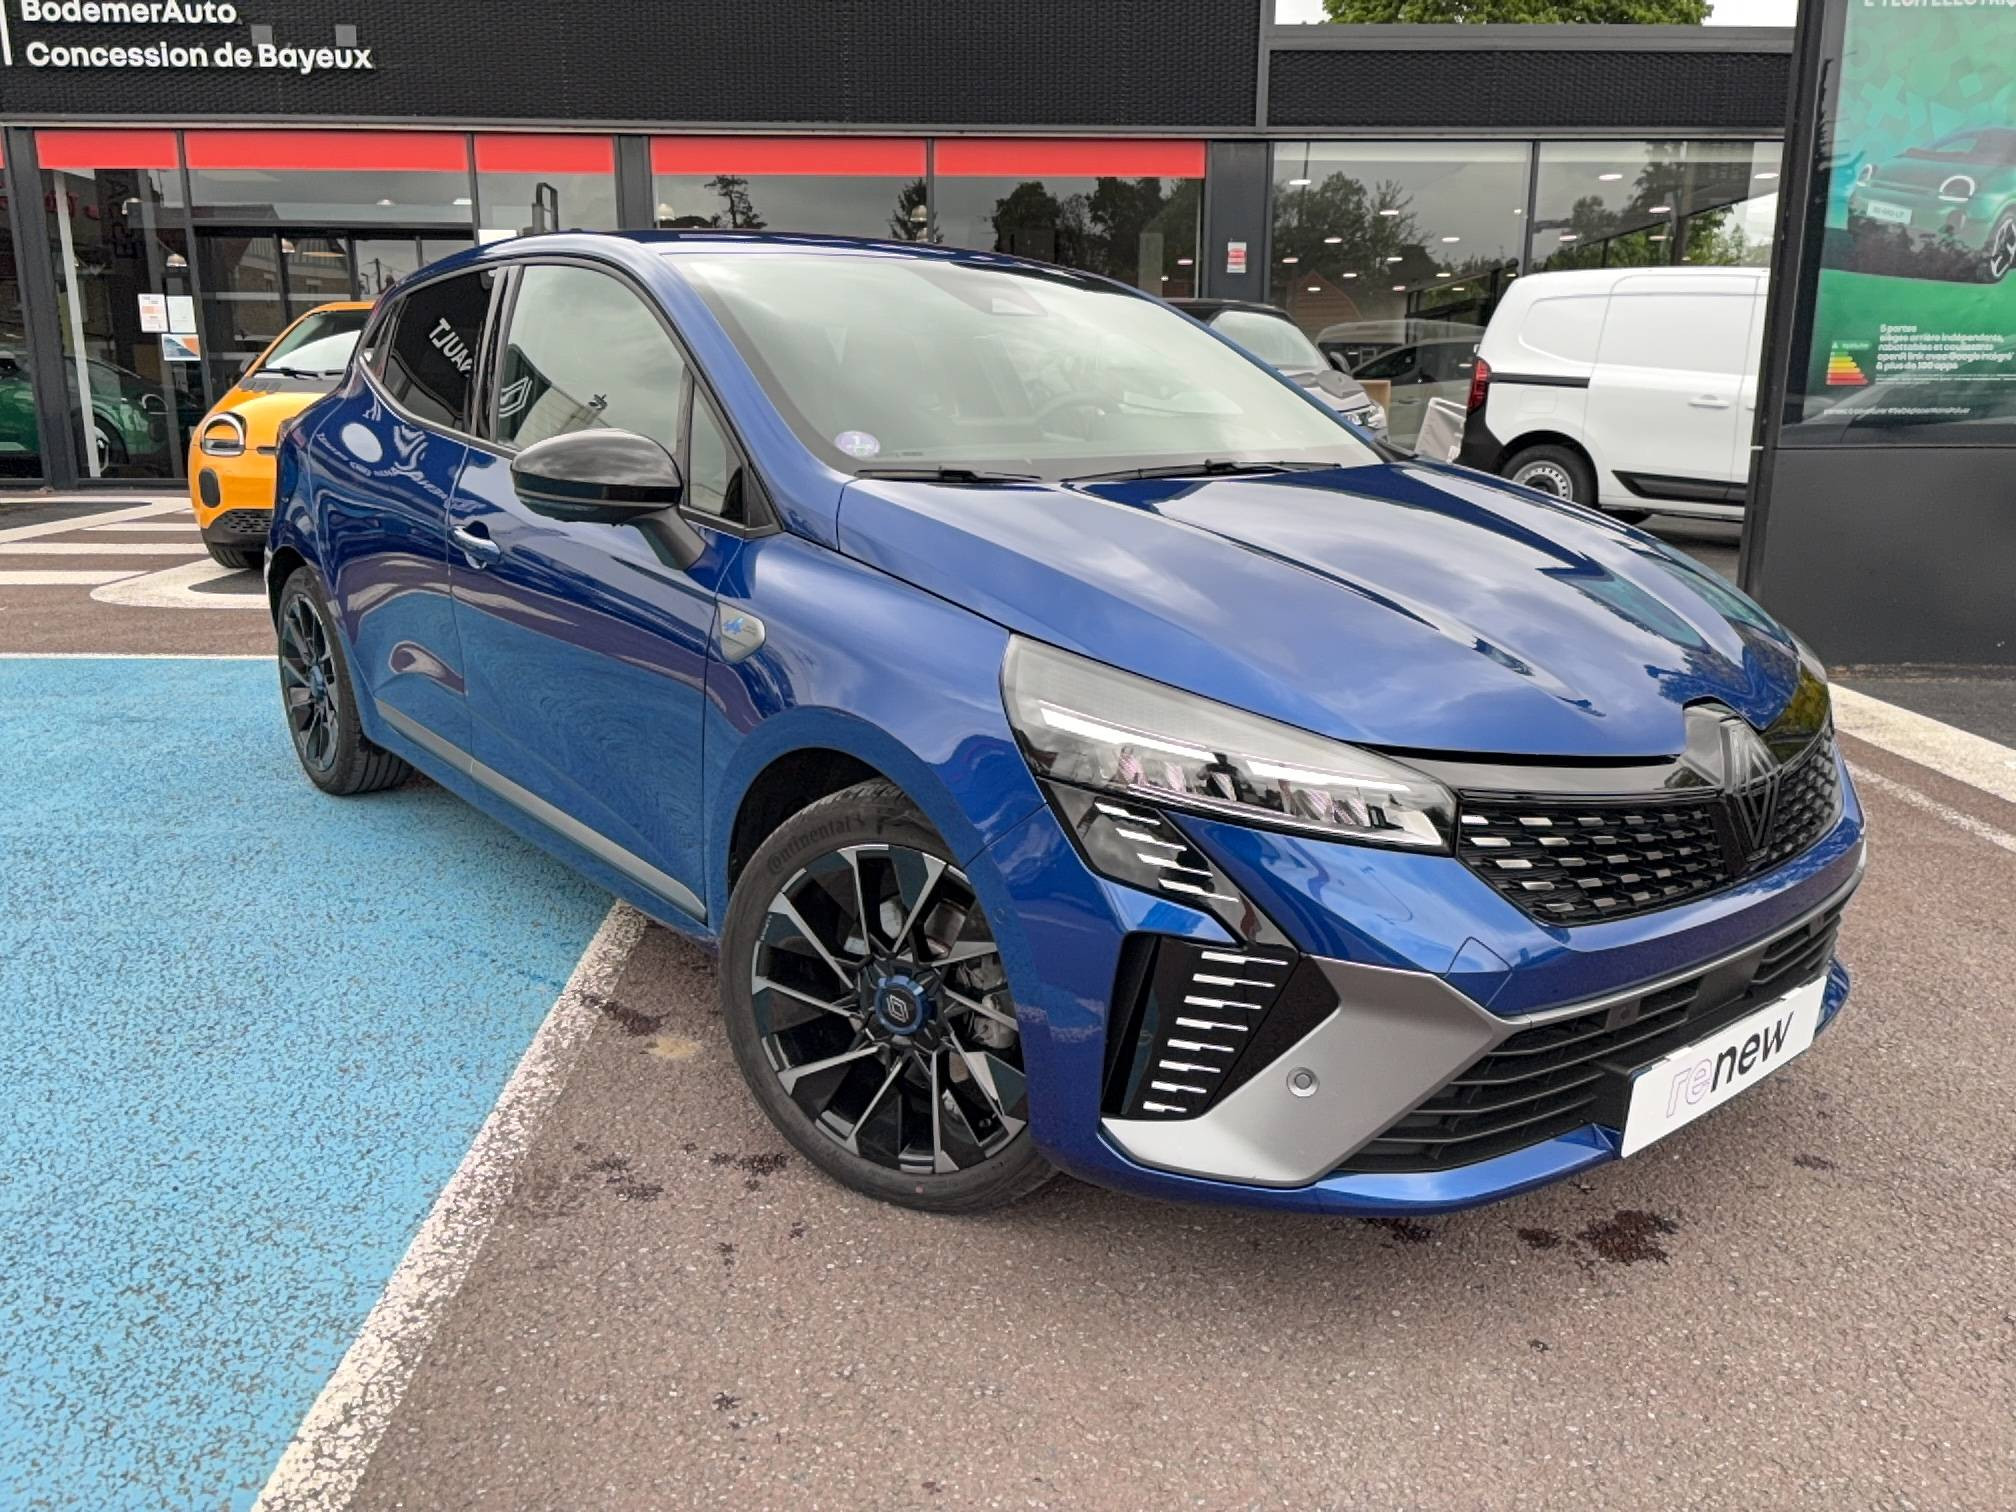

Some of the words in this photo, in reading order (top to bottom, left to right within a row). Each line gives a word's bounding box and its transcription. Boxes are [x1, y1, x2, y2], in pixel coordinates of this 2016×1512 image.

[21, 0, 238, 24] BodemerAuto
[26, 41, 209, 67] Concession
[213, 41, 253, 68] de
[257, 43, 374, 75] Bayeux
[1666, 1011, 1795, 1118] renew
